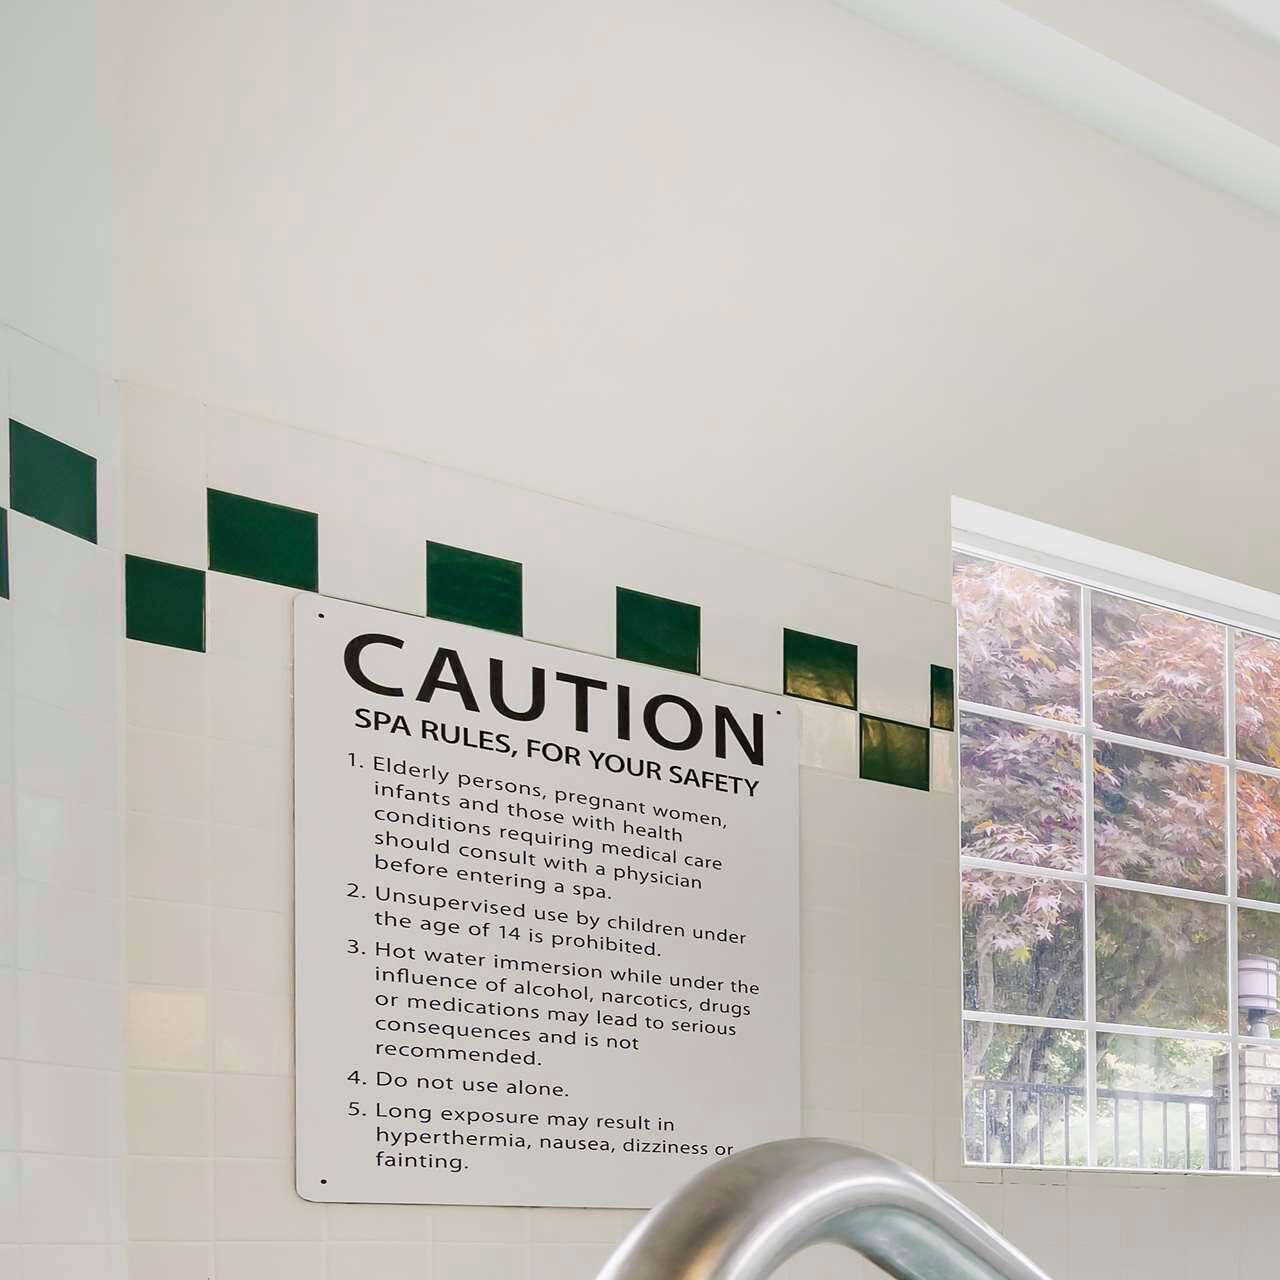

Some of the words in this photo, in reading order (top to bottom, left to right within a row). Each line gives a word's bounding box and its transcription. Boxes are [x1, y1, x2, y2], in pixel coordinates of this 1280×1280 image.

[343, 632, 765, 767] CAUTION
[354, 707, 413, 738] SPA
[420, 718, 519, 759] RULES,
[526, 738, 582, 768] FOR
[587, 749, 663, 782] YOUR
[668, 764, 761, 798] SAFETY
[347, 751, 365, 769] 1.
[372, 755, 451, 786] Elderly
[457, 772, 547, 801] persons,
[554, 789, 647, 816] pregnant
[651, 805, 728, 830] women,
[374, 780, 452, 808] infants
[458, 797, 500, 815] and
[506, 801, 565, 825] those
[571, 814, 616, 833] with
[622, 818, 684, 844] health
[373, 808, 492, 838] conditions
[499, 826, 594, 856] requiring
[600, 842, 678, 865] medical
[683, 855, 723, 871] care
[374, 829, 451, 856] should
[457, 845, 537, 868] consult
[542, 855, 589, 875] with
[594, 864, 607, 877] a
[613, 864, 703, 890] physician
[374, 853, 449, 879] before
[455, 868, 547, 896] entering
[553, 881, 565, 894] a
[571, 883, 613, 901] spa.
[346, 882, 367, 900] 2.
[374, 884, 526, 919] Unsupervised
[533, 908, 570, 924] use
[575, 909, 602, 931] by
[606, 914, 686, 938] children
[692, 927, 747, 945] under
[373, 909, 413, 930] the
[419, 918, 461, 937] age
[467, 921, 492, 938] of
[498, 924, 522, 942] 14
[528, 927, 545, 945] is
[550, 933, 662, 958] prohibited.
[346, 938, 367, 956] 3.
[374, 940, 417, 961] Hot
[423, 949, 487, 968] water
[493, 953, 603, 980] immersion
[609, 966, 663, 986] while
[668, 974, 725, 992] under
[729, 978, 760, 996] the
[374, 965, 479, 991] influence
[484, 976, 509, 994] of
[513, 979, 595, 1004] alcohol,
[601, 991, 694, 1014] narcotics,
[698, 996, 751, 1019] drugs
[374, 993, 400, 1008] or
[406, 995, 541, 1020] medications
[546, 1009, 590, 1028] may
[596, 1009, 639, 1029] lead
[643, 1015, 665, 1031] to
[670, 1019, 737, 1037] serious
[374, 1018, 532, 1043] consequences
[537, 1029, 578, 1046] and
[584, 1031, 600, 1048] is
[605, 1036, 640, 1051] not
[375, 1043, 543, 1067] recommended.
[346, 1069, 368, 1086] 4.
[375, 1070, 409, 1089] Do
[416, 1076, 455, 1091] not
[461, 1079, 499, 1094] use
[505, 1078, 569, 1098] alone.
[347, 1100, 368, 1117] 5.
[375, 1101, 432, 1125] Long
[439, 1108, 540, 1127] exposure
[546, 1114, 590, 1132] may
[596, 1115, 652, 1132] result
[657, 1116, 675, 1132] in
[376, 1125, 532, 1151] hyperthermia,
[539, 1137, 616, 1154] nausea,
[621, 1137, 709, 1156] dizziness
[714, 1144, 735, 1157] or
[375, 1149, 469, 1174] fainting.
